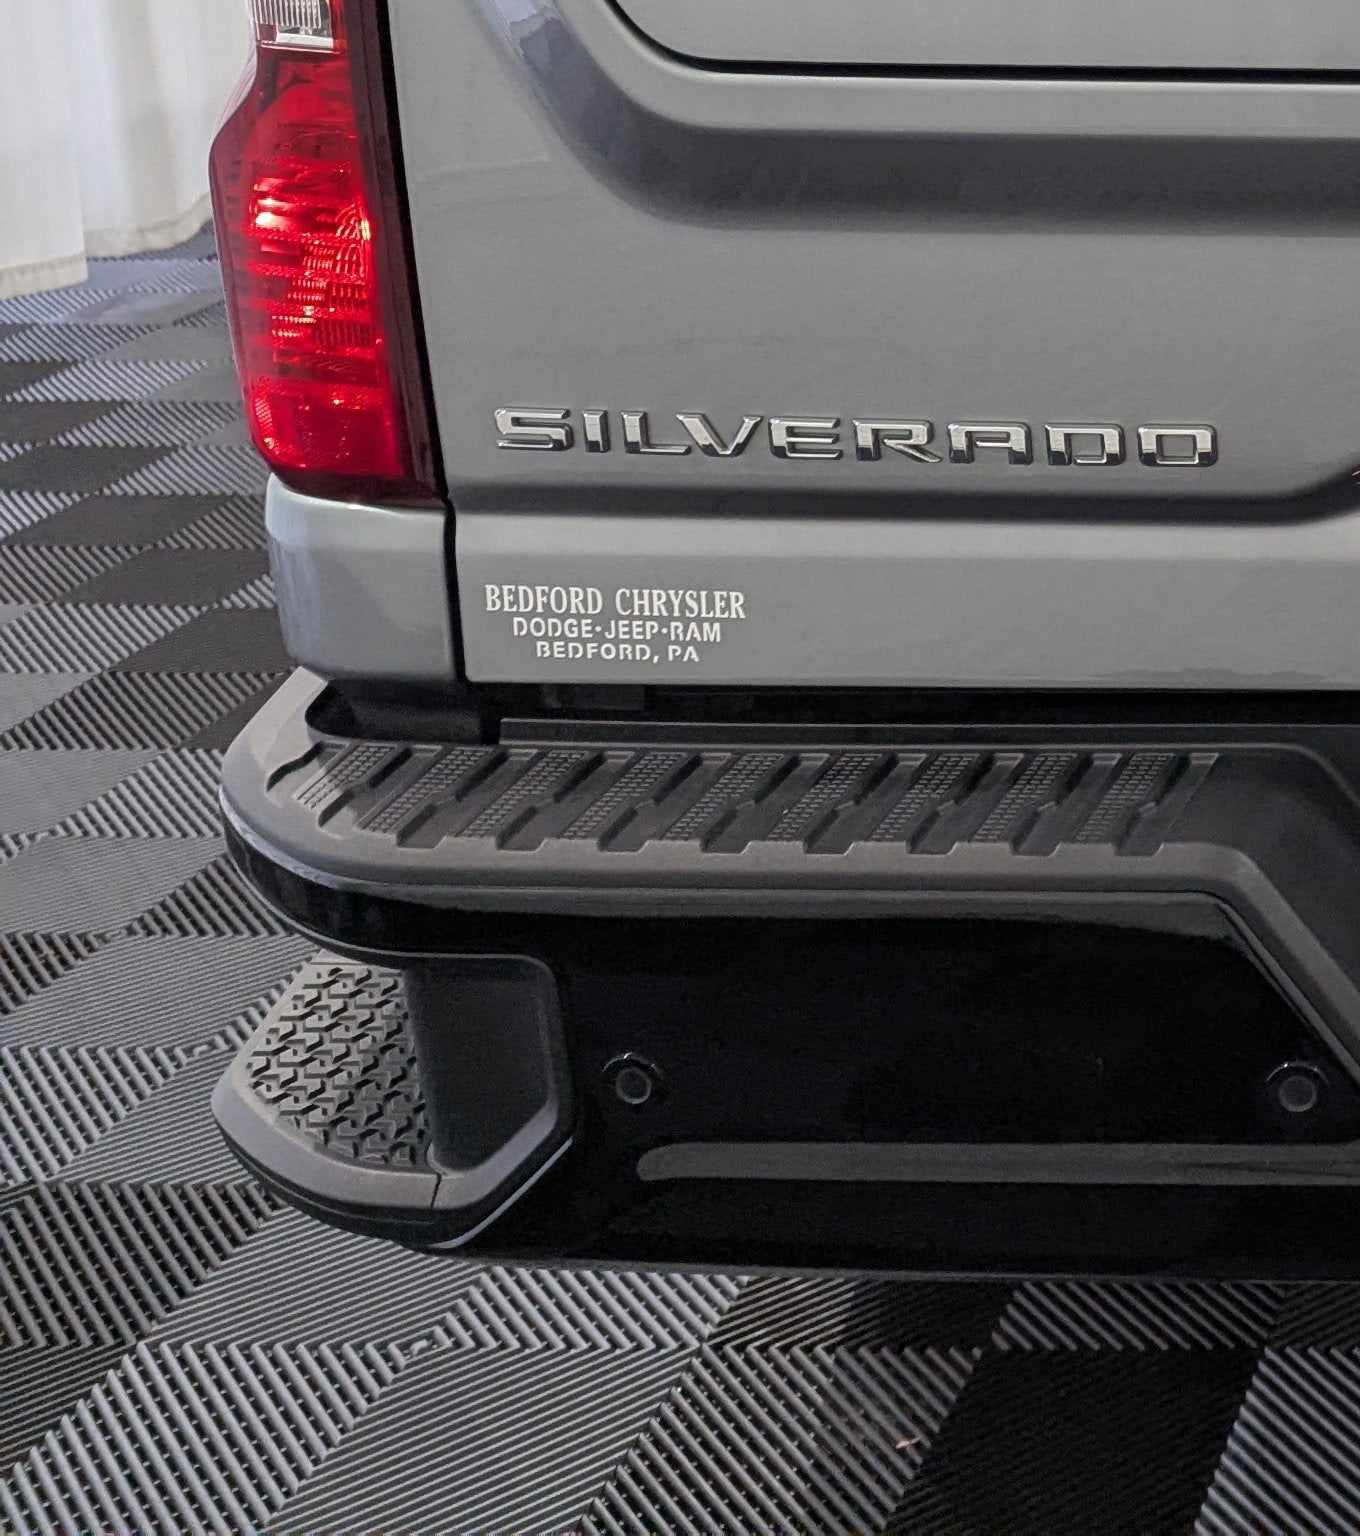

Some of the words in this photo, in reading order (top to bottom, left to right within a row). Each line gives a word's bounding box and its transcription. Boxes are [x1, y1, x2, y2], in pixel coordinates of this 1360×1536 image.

[494, 406, 1219, 466] SILVERADO
[484, 584, 603, 615] BEDFORD
[615, 587, 747, 619] CHRYSLER
[535, 641, 660, 664] BEDFORD,
[668, 645, 700, 663] PA
